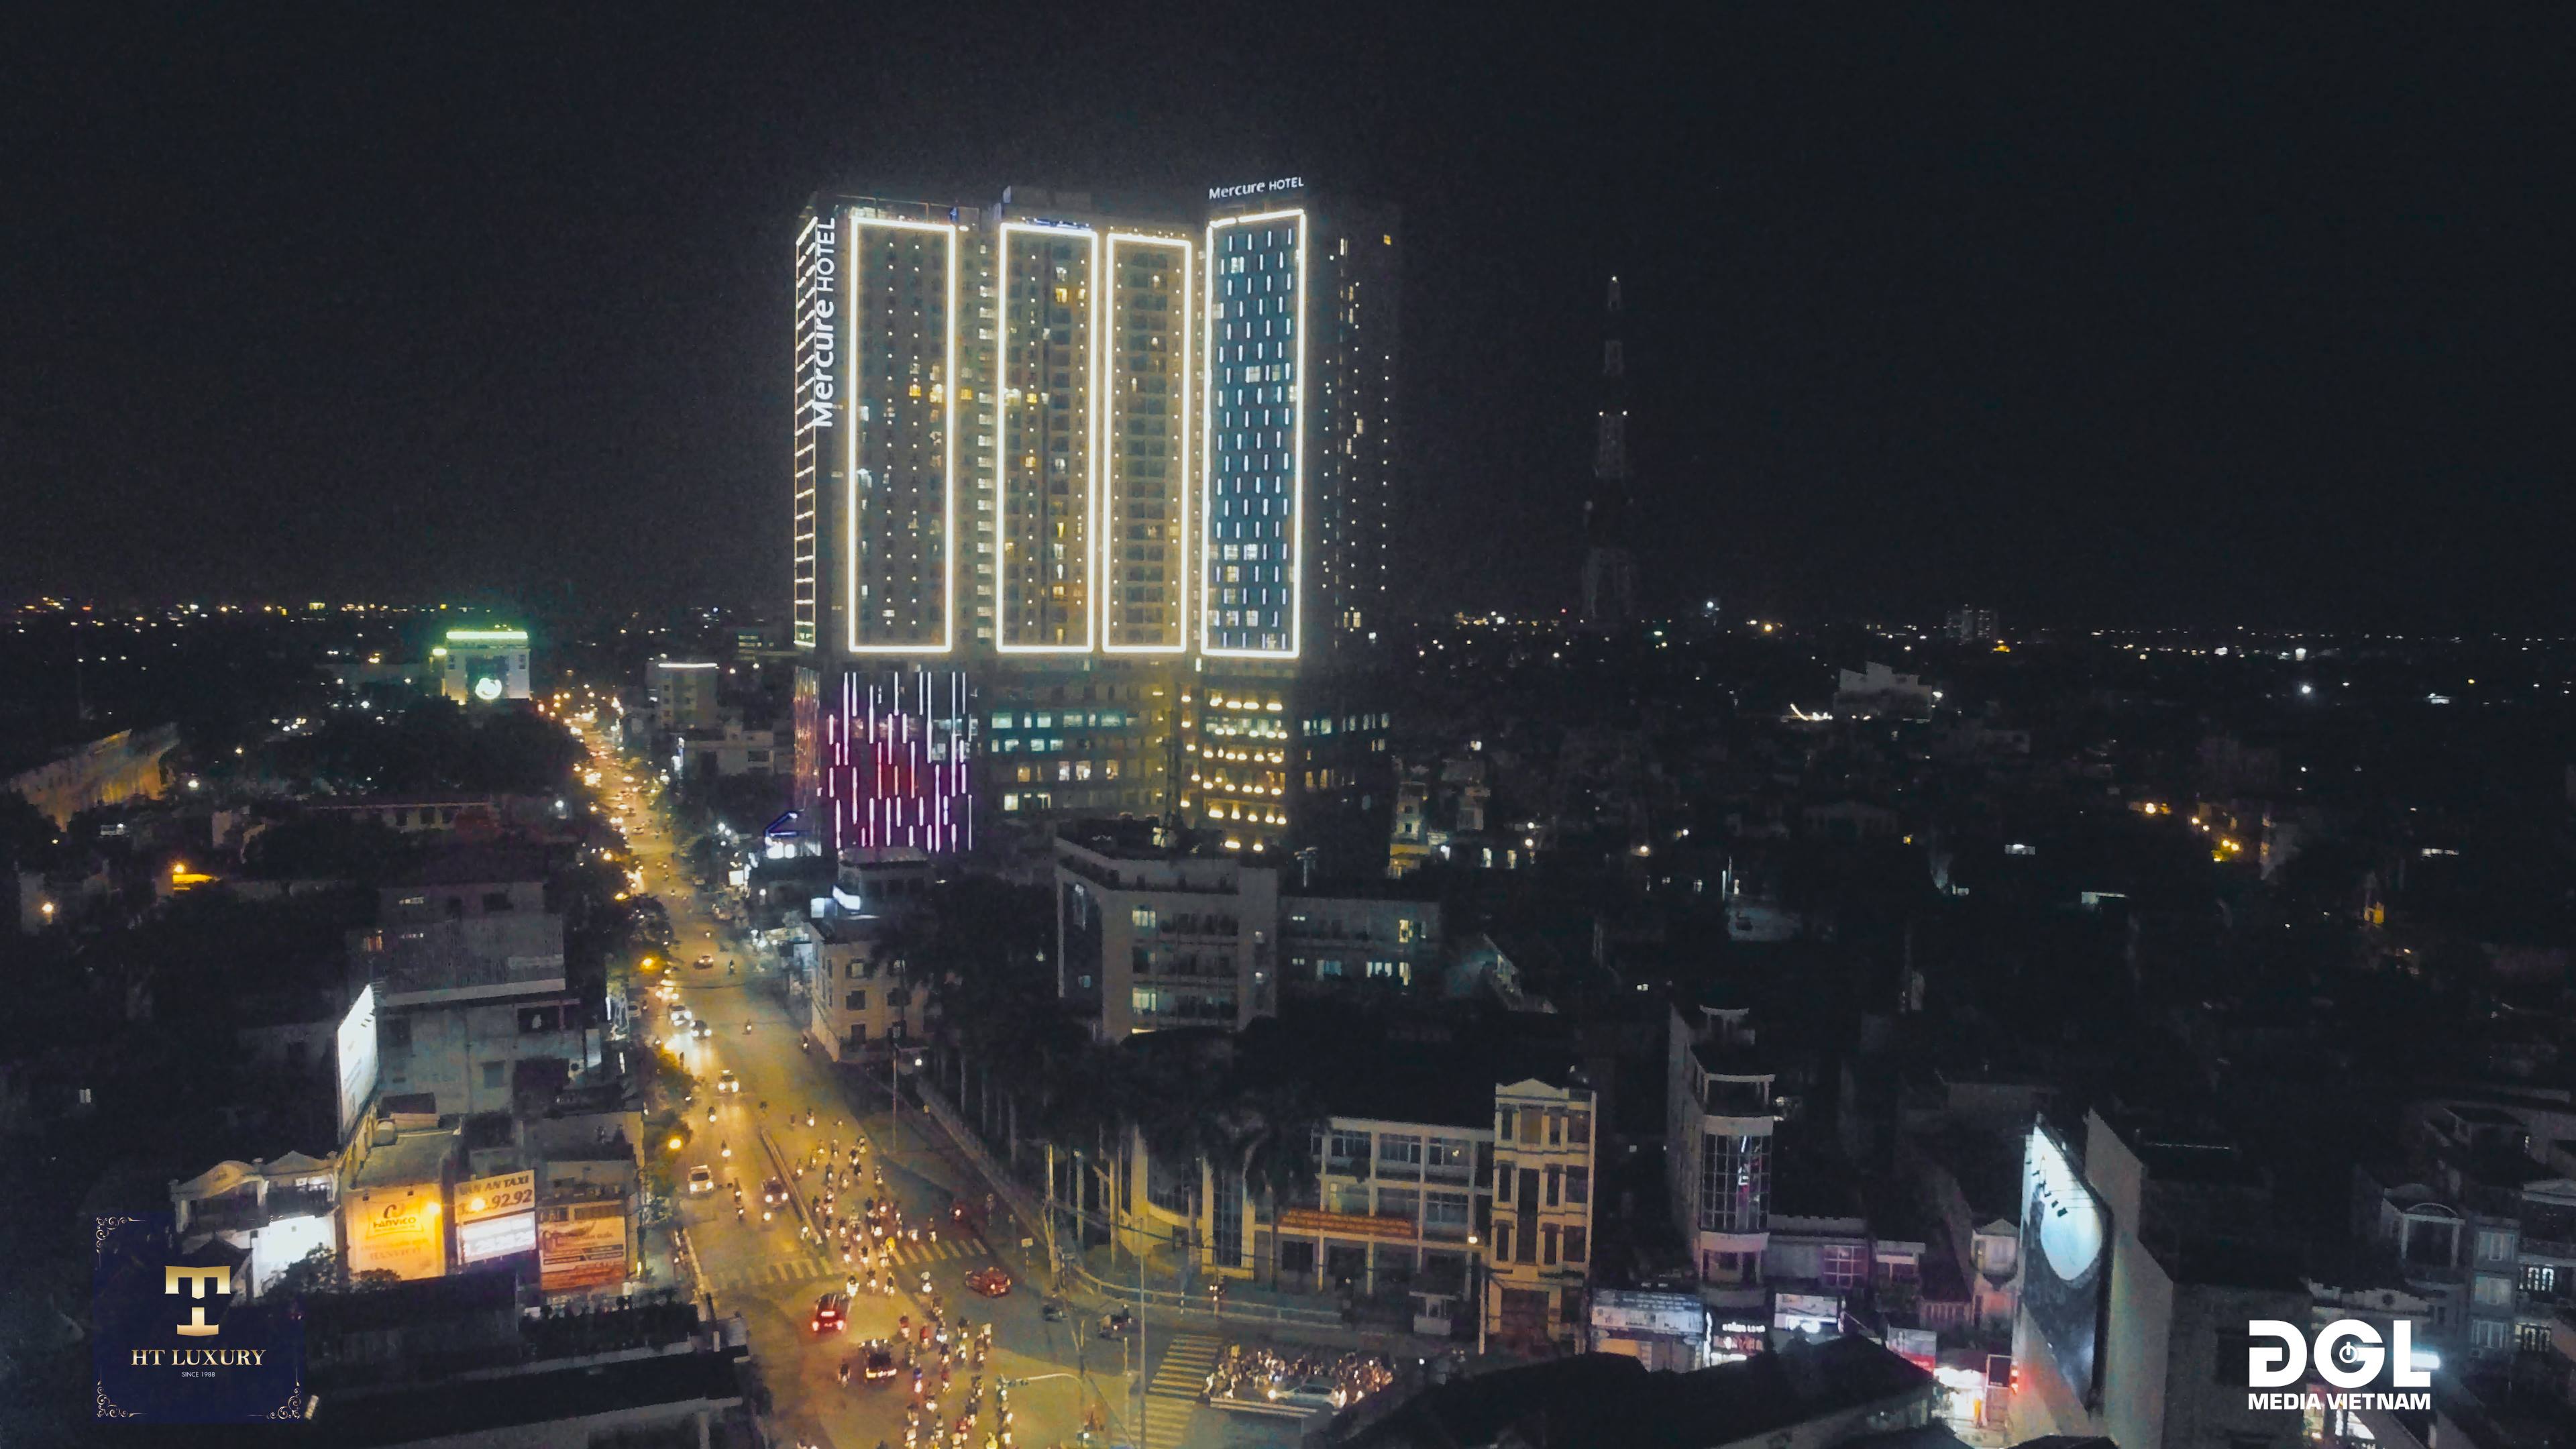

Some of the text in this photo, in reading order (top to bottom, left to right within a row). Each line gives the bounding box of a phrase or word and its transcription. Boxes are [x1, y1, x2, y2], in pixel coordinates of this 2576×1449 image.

[1209, 177, 1304, 200] Mercure HOTEL
[812, 217, 835, 427] Mercure HOTEL
[504, 1175, 529, 1187] TAXI
